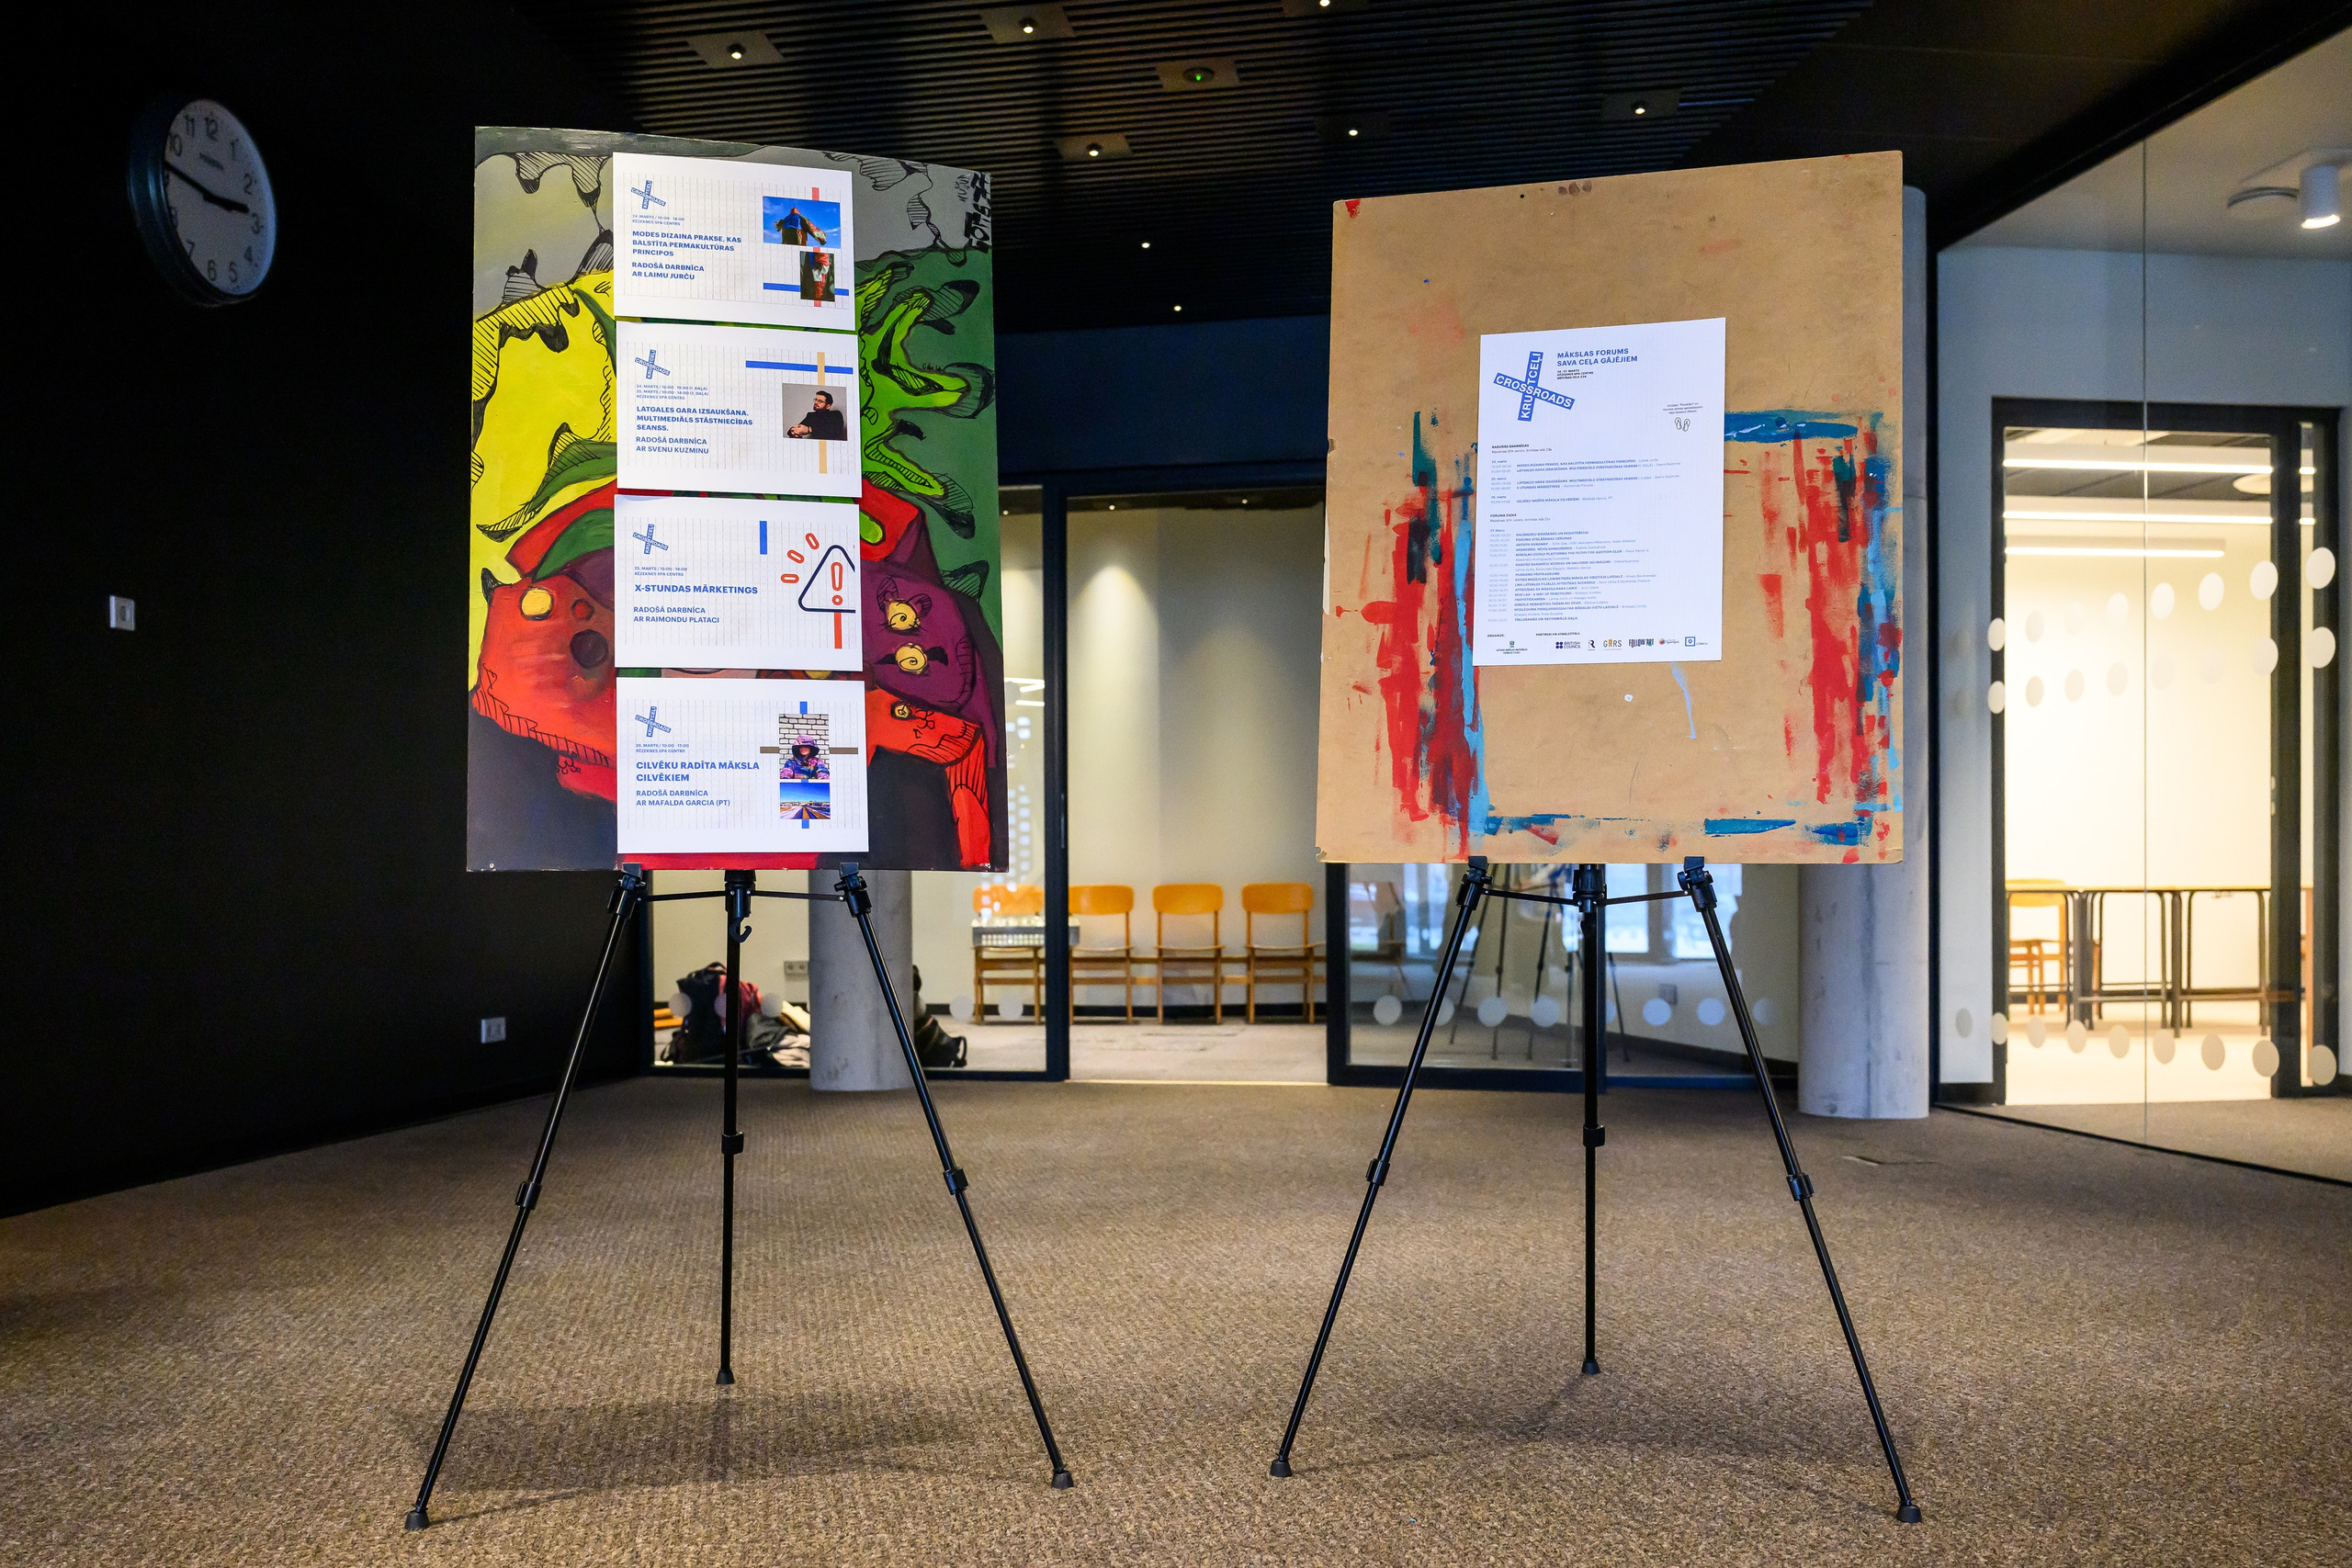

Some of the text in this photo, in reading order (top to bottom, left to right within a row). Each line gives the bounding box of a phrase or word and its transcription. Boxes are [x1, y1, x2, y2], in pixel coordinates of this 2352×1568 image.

[633, 240, 734, 252] BALSTĪTA PERMAKULTŪRAS
[632, 262, 704, 272] RADOŠĀ DARBNĪCA
[1557, 348, 1628, 359] MĀKSLAS FORUMS
[1601, 355, 1637, 364] GĀJĒJIEM
[1521, 352, 1543, 419] KRUSTCEĻI
[1496, 375, 1572, 408] CROSSROADS
[637, 415, 752, 426] MULTIMEDIĀLS STĀSTNIECĪBAS
[635, 584, 758, 594] X-STUNDAS MĀRKETINGS
[636, 761, 759, 769] CILVĒKU RADĪTA MĀKSLA
[637, 773, 689, 781] CILVĒKIEM
